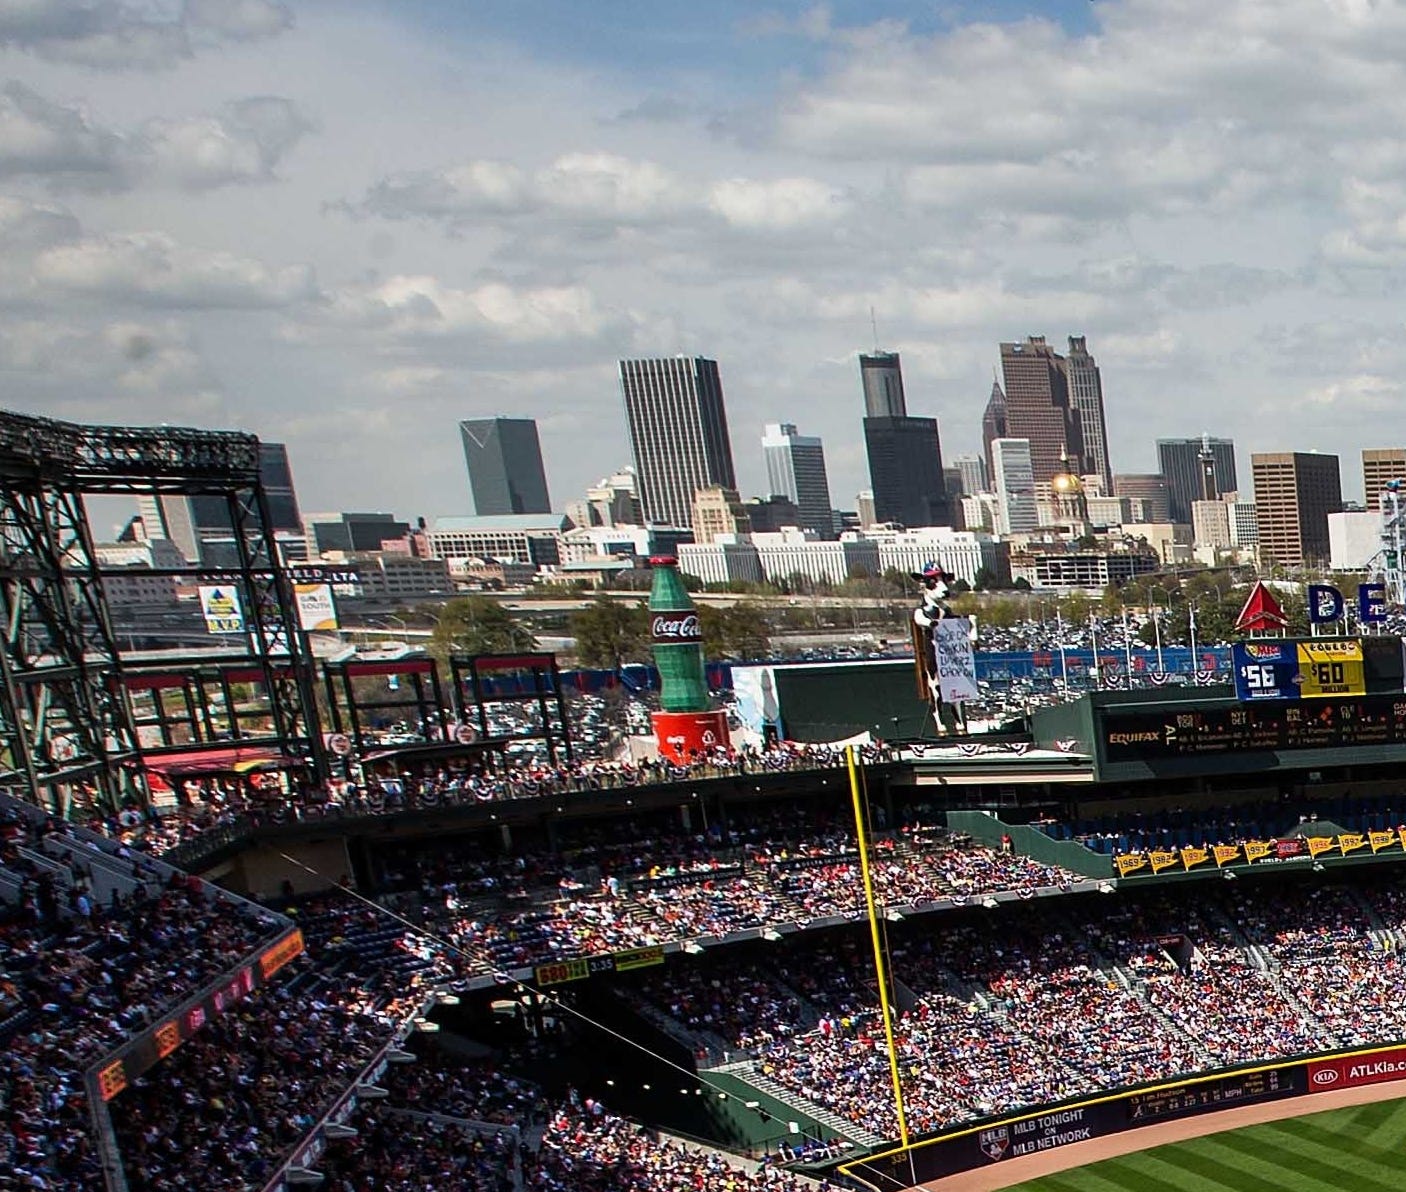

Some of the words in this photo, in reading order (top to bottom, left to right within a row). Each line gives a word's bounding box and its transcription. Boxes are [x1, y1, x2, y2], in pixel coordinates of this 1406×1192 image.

[1312, 663, 1344, 685] $60
[1110, 732, 1160, 745] EQUIFAX
[1120, 859, 1139, 868] 1969
[1153, 856, 1171, 866] 1982
[591, 960, 614, 972] 3:35
[1315, 1070, 1337, 1082] KIA
[1225, 1088, 1242, 1098] MPH
[1014, 1121, 1036, 1136] MLB
[1039, 1109, 1085, 1128] TONIGHT
[981, 1127, 1007, 1144] MLB
[1044, 1126, 1057, 1135] ON
[1013, 1142, 1035, 1156] MLB
[1037, 1127, 1091, 1149] NETWORK
